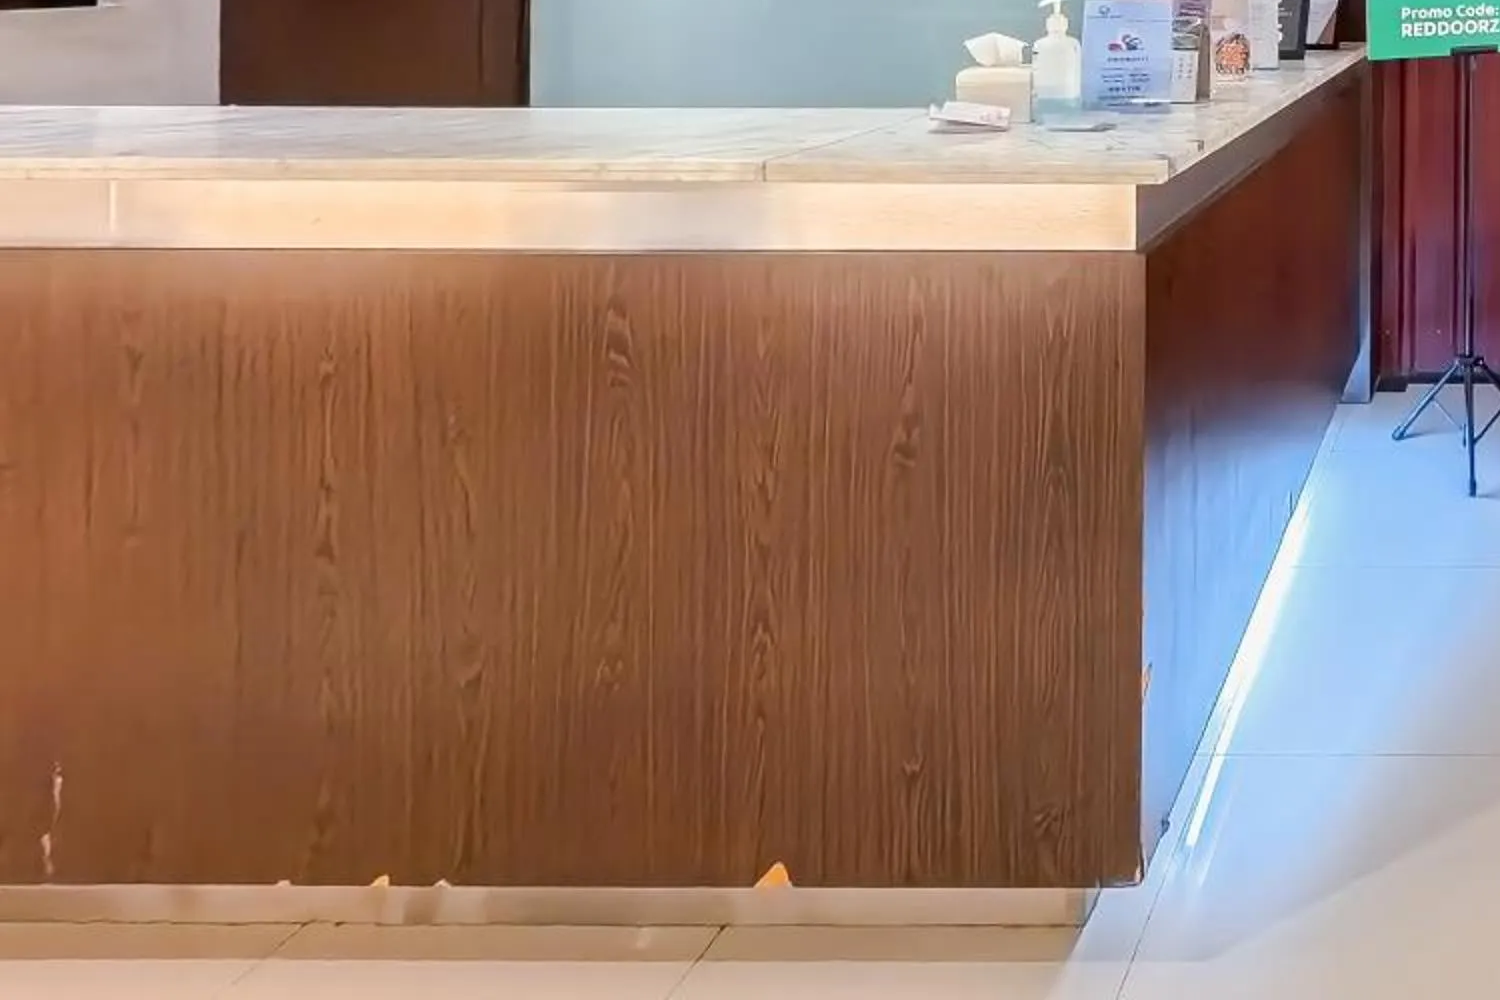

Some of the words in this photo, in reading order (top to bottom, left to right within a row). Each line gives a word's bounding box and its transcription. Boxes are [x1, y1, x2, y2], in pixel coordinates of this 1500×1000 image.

[1401, 6, 1453, 20] Promo
[1456, 3, 1500, 18] Code:
[1401, 19, 1500, 38] REDDOORZ
